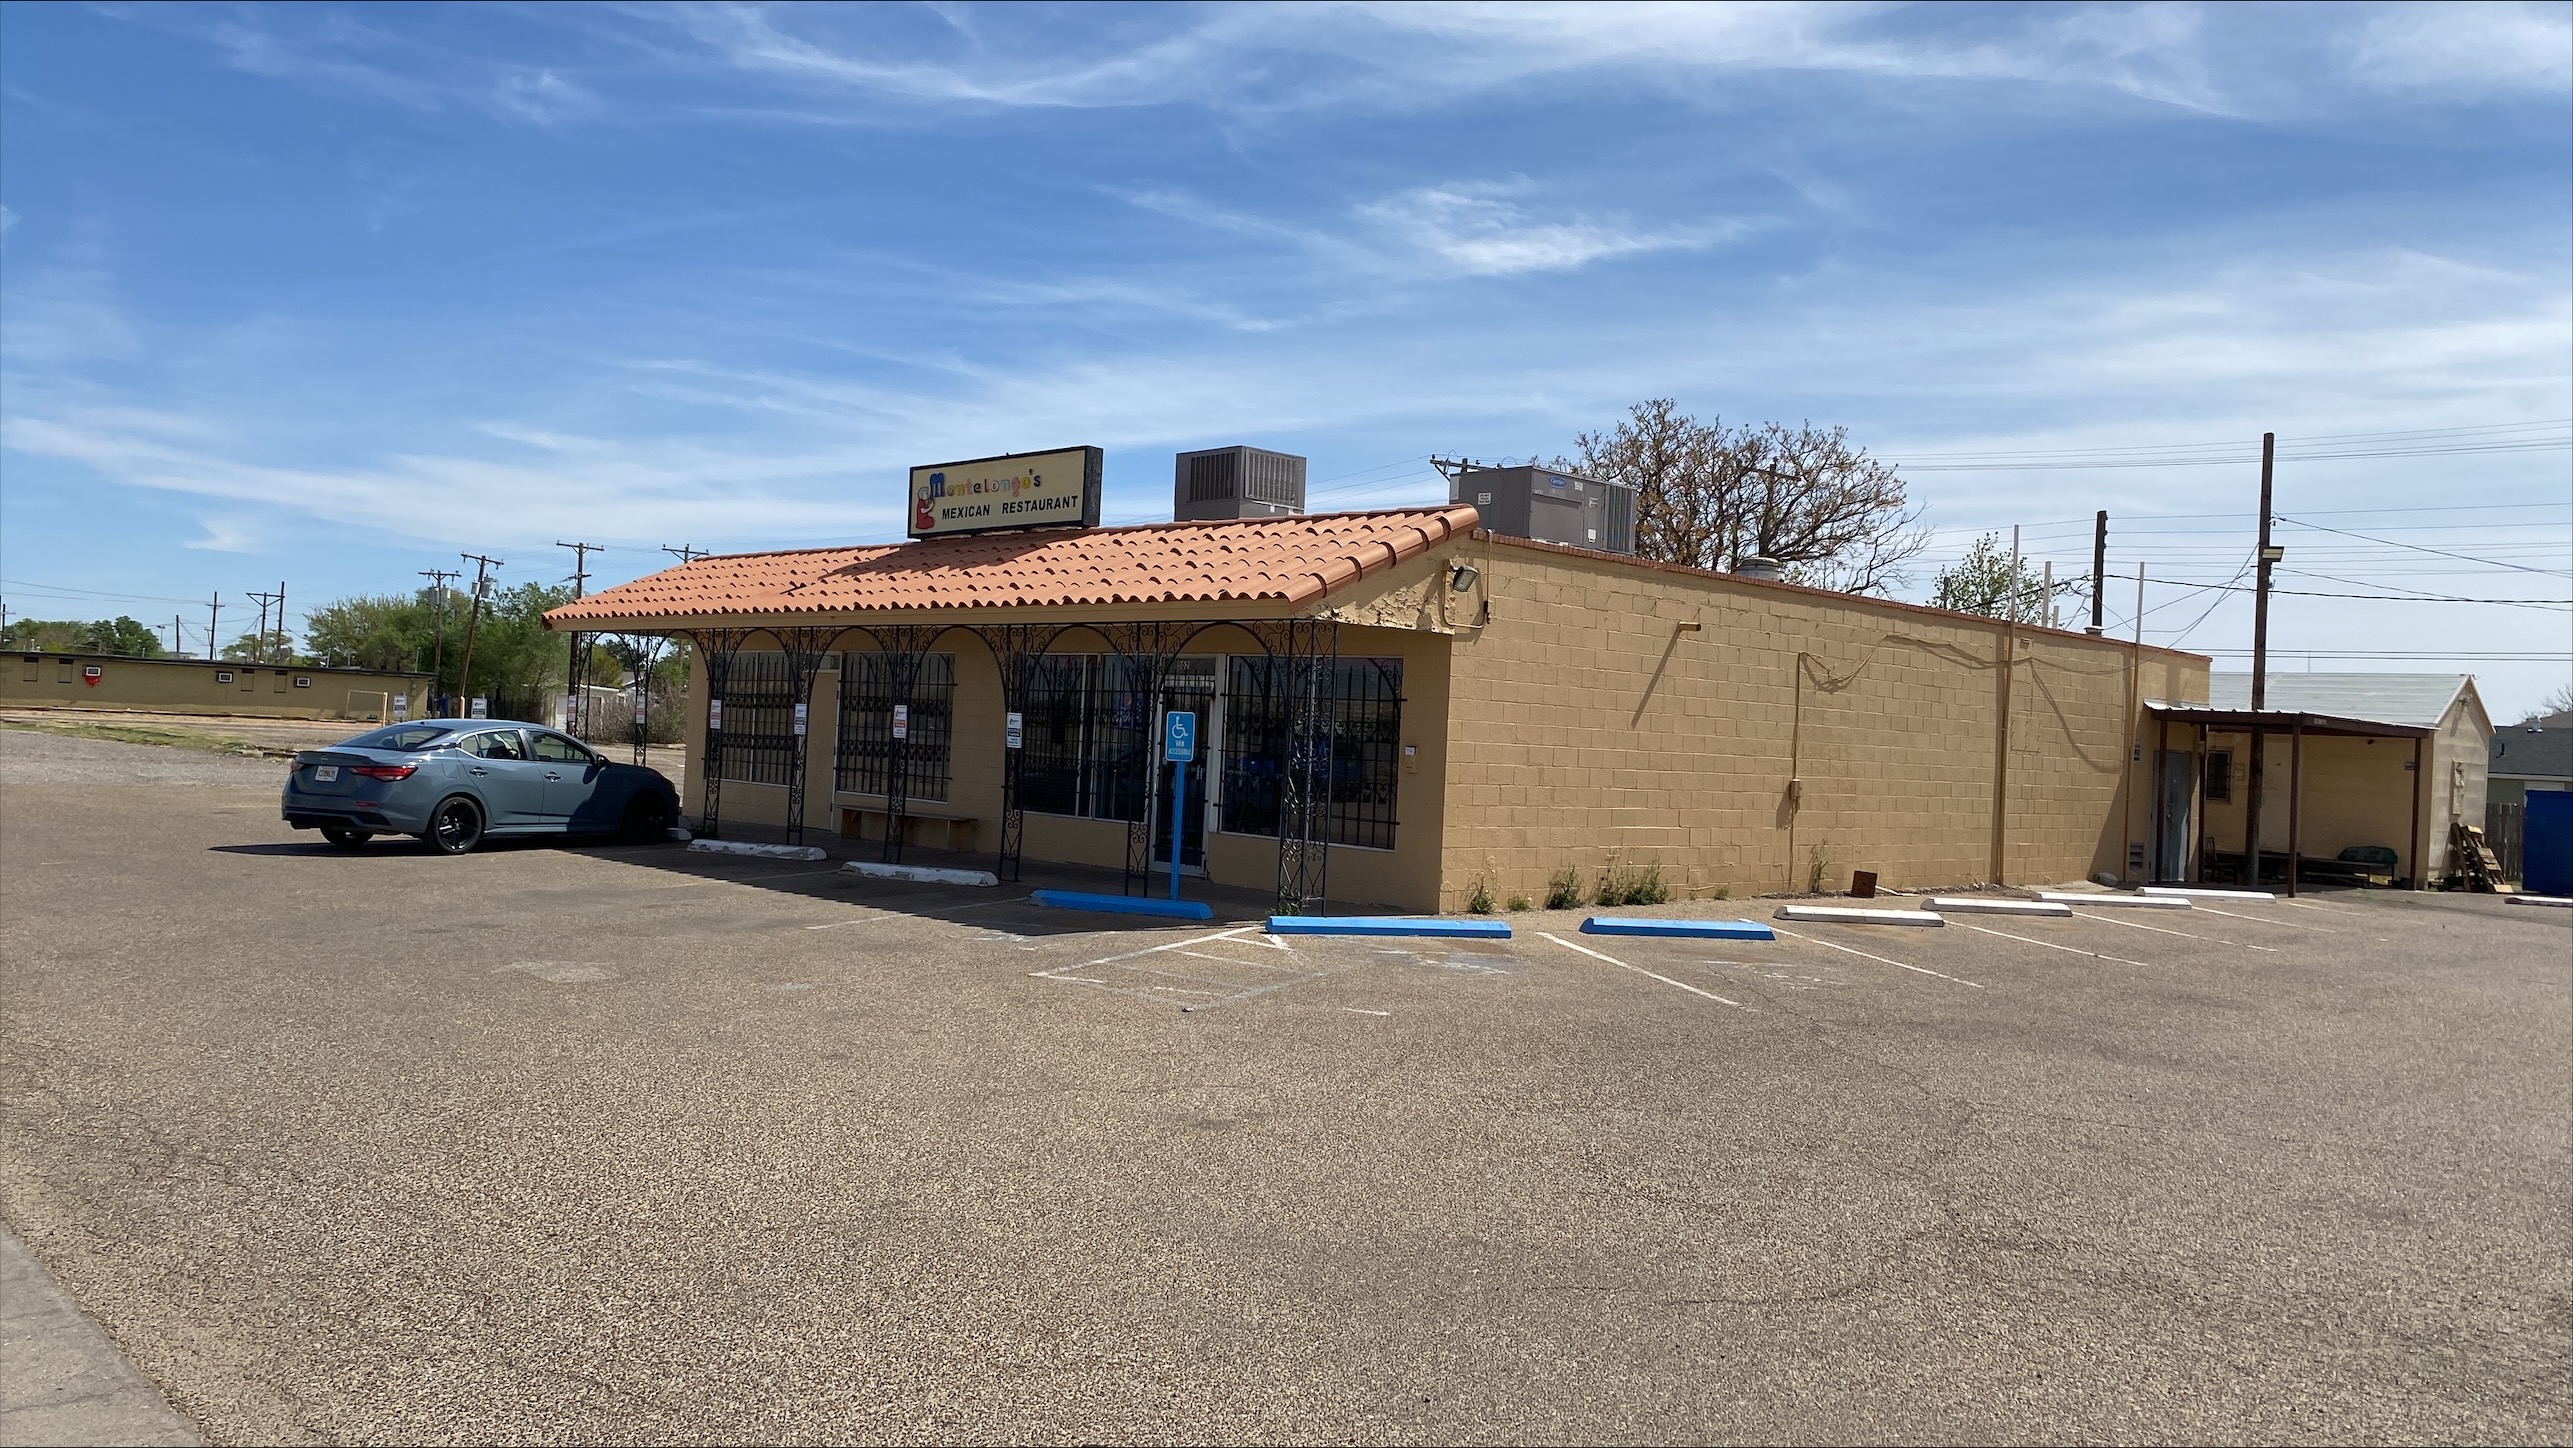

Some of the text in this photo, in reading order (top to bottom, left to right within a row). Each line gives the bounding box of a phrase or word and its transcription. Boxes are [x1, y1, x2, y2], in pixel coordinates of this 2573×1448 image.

[930, 468, 1041, 498] Montelongo's
[942, 495, 1078, 520] MEXICAN RESTAURANT
[1175, 740, 1185, 748] VAN
